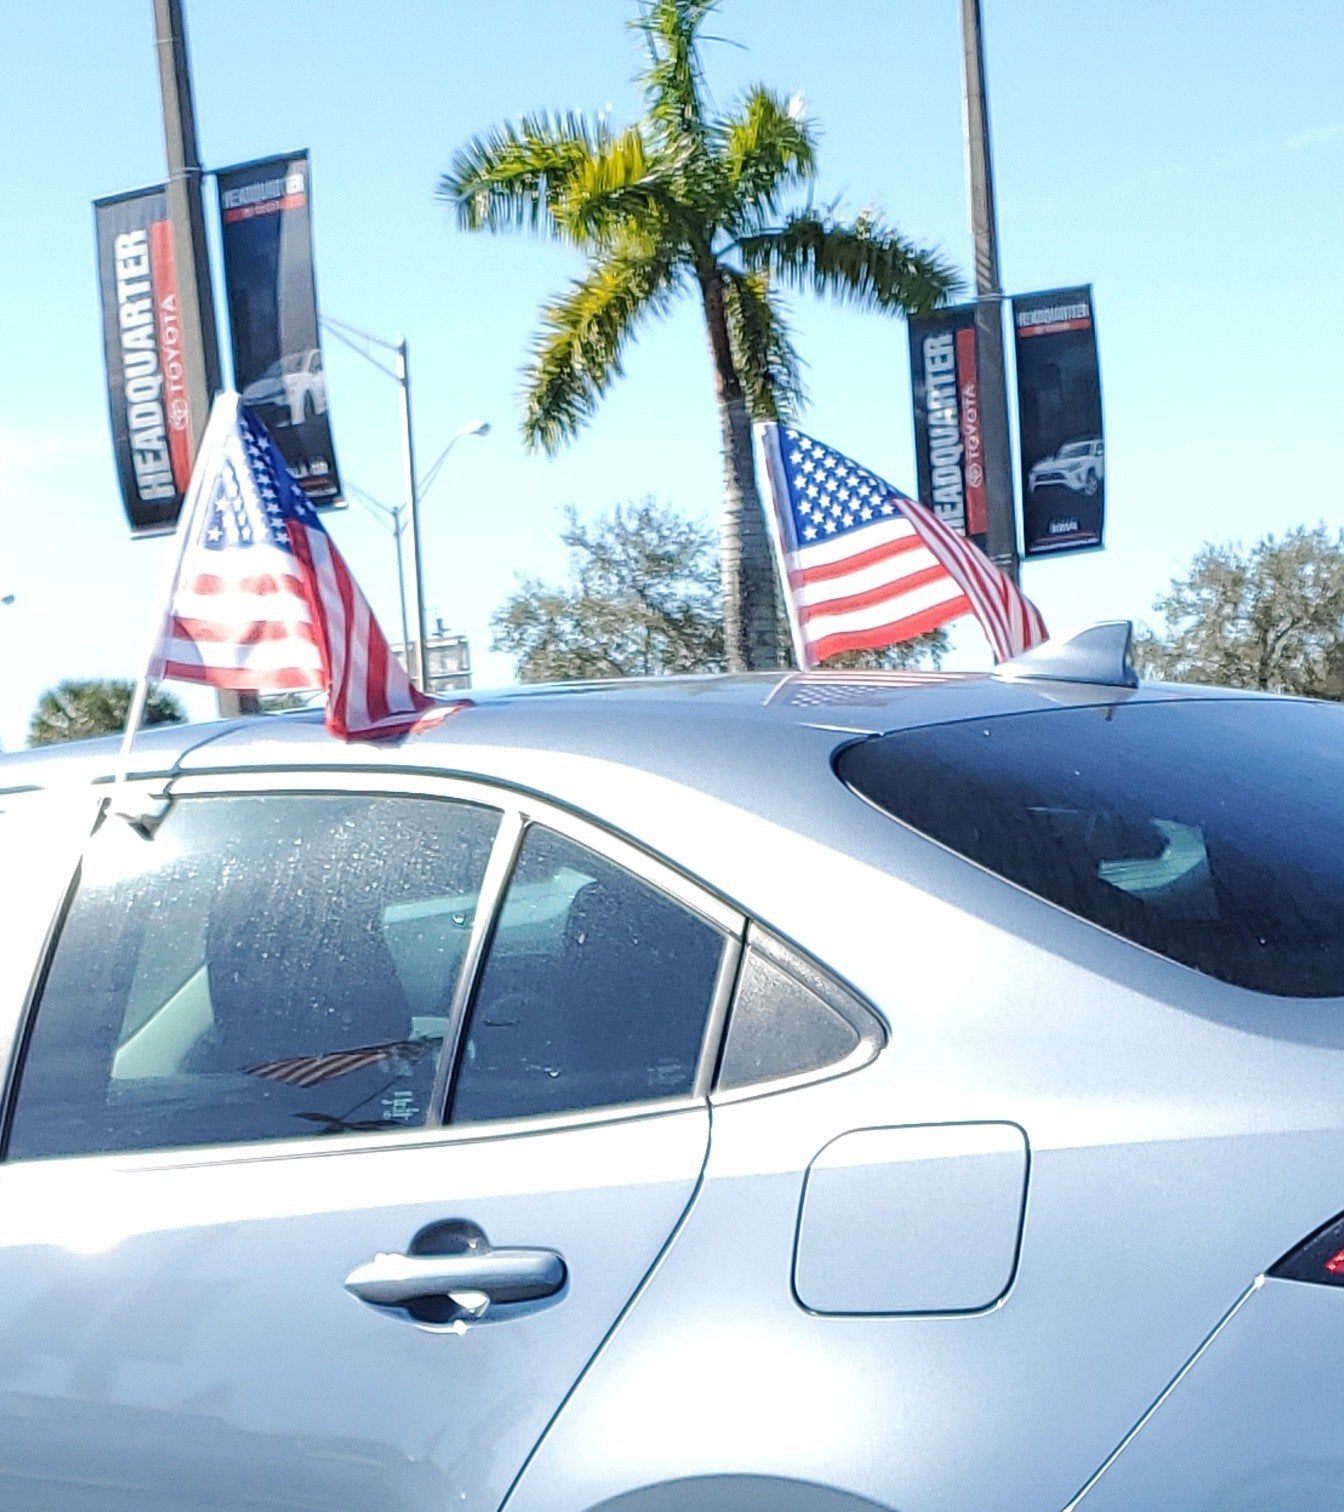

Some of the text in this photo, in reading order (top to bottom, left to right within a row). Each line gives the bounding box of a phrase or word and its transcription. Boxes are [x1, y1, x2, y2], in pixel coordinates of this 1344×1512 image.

[115, 229, 176, 500] HEADQUARTER
[162, 293, 184, 393] TOYOTA
[962, 383, 980, 458] TOYOTA
